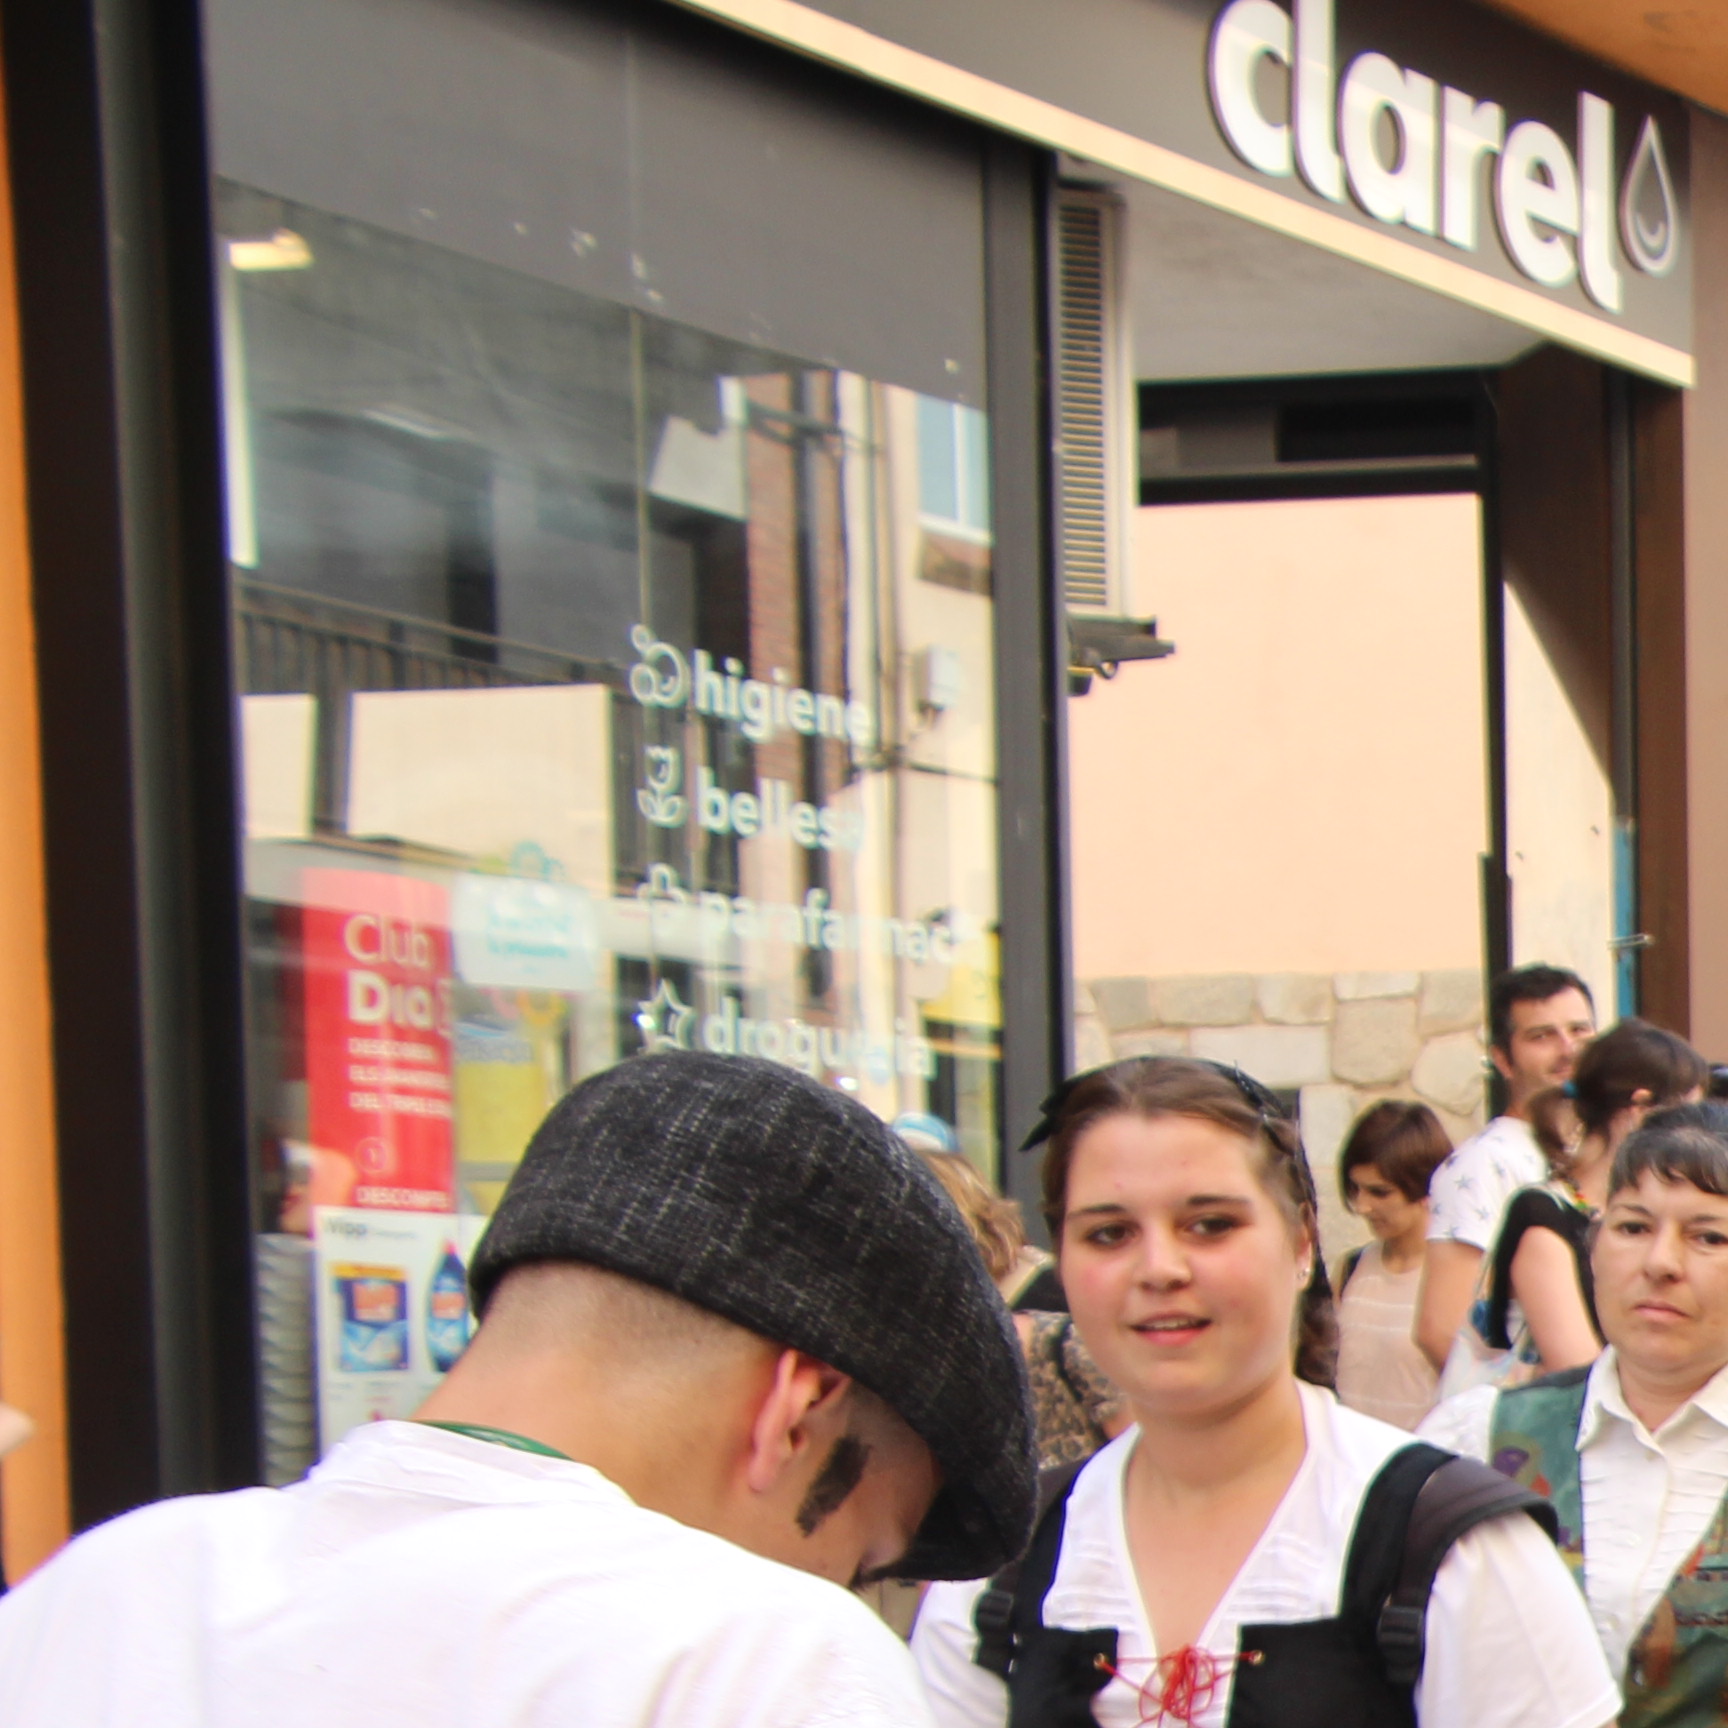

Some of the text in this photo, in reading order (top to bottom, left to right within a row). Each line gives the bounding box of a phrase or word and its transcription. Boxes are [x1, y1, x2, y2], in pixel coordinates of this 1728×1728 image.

[1207, 0, 1624, 315] clarel
[694, 648, 877, 748] higiene
[343, 914, 431, 969] Club
[703, 996, 937, 1081] droguia
